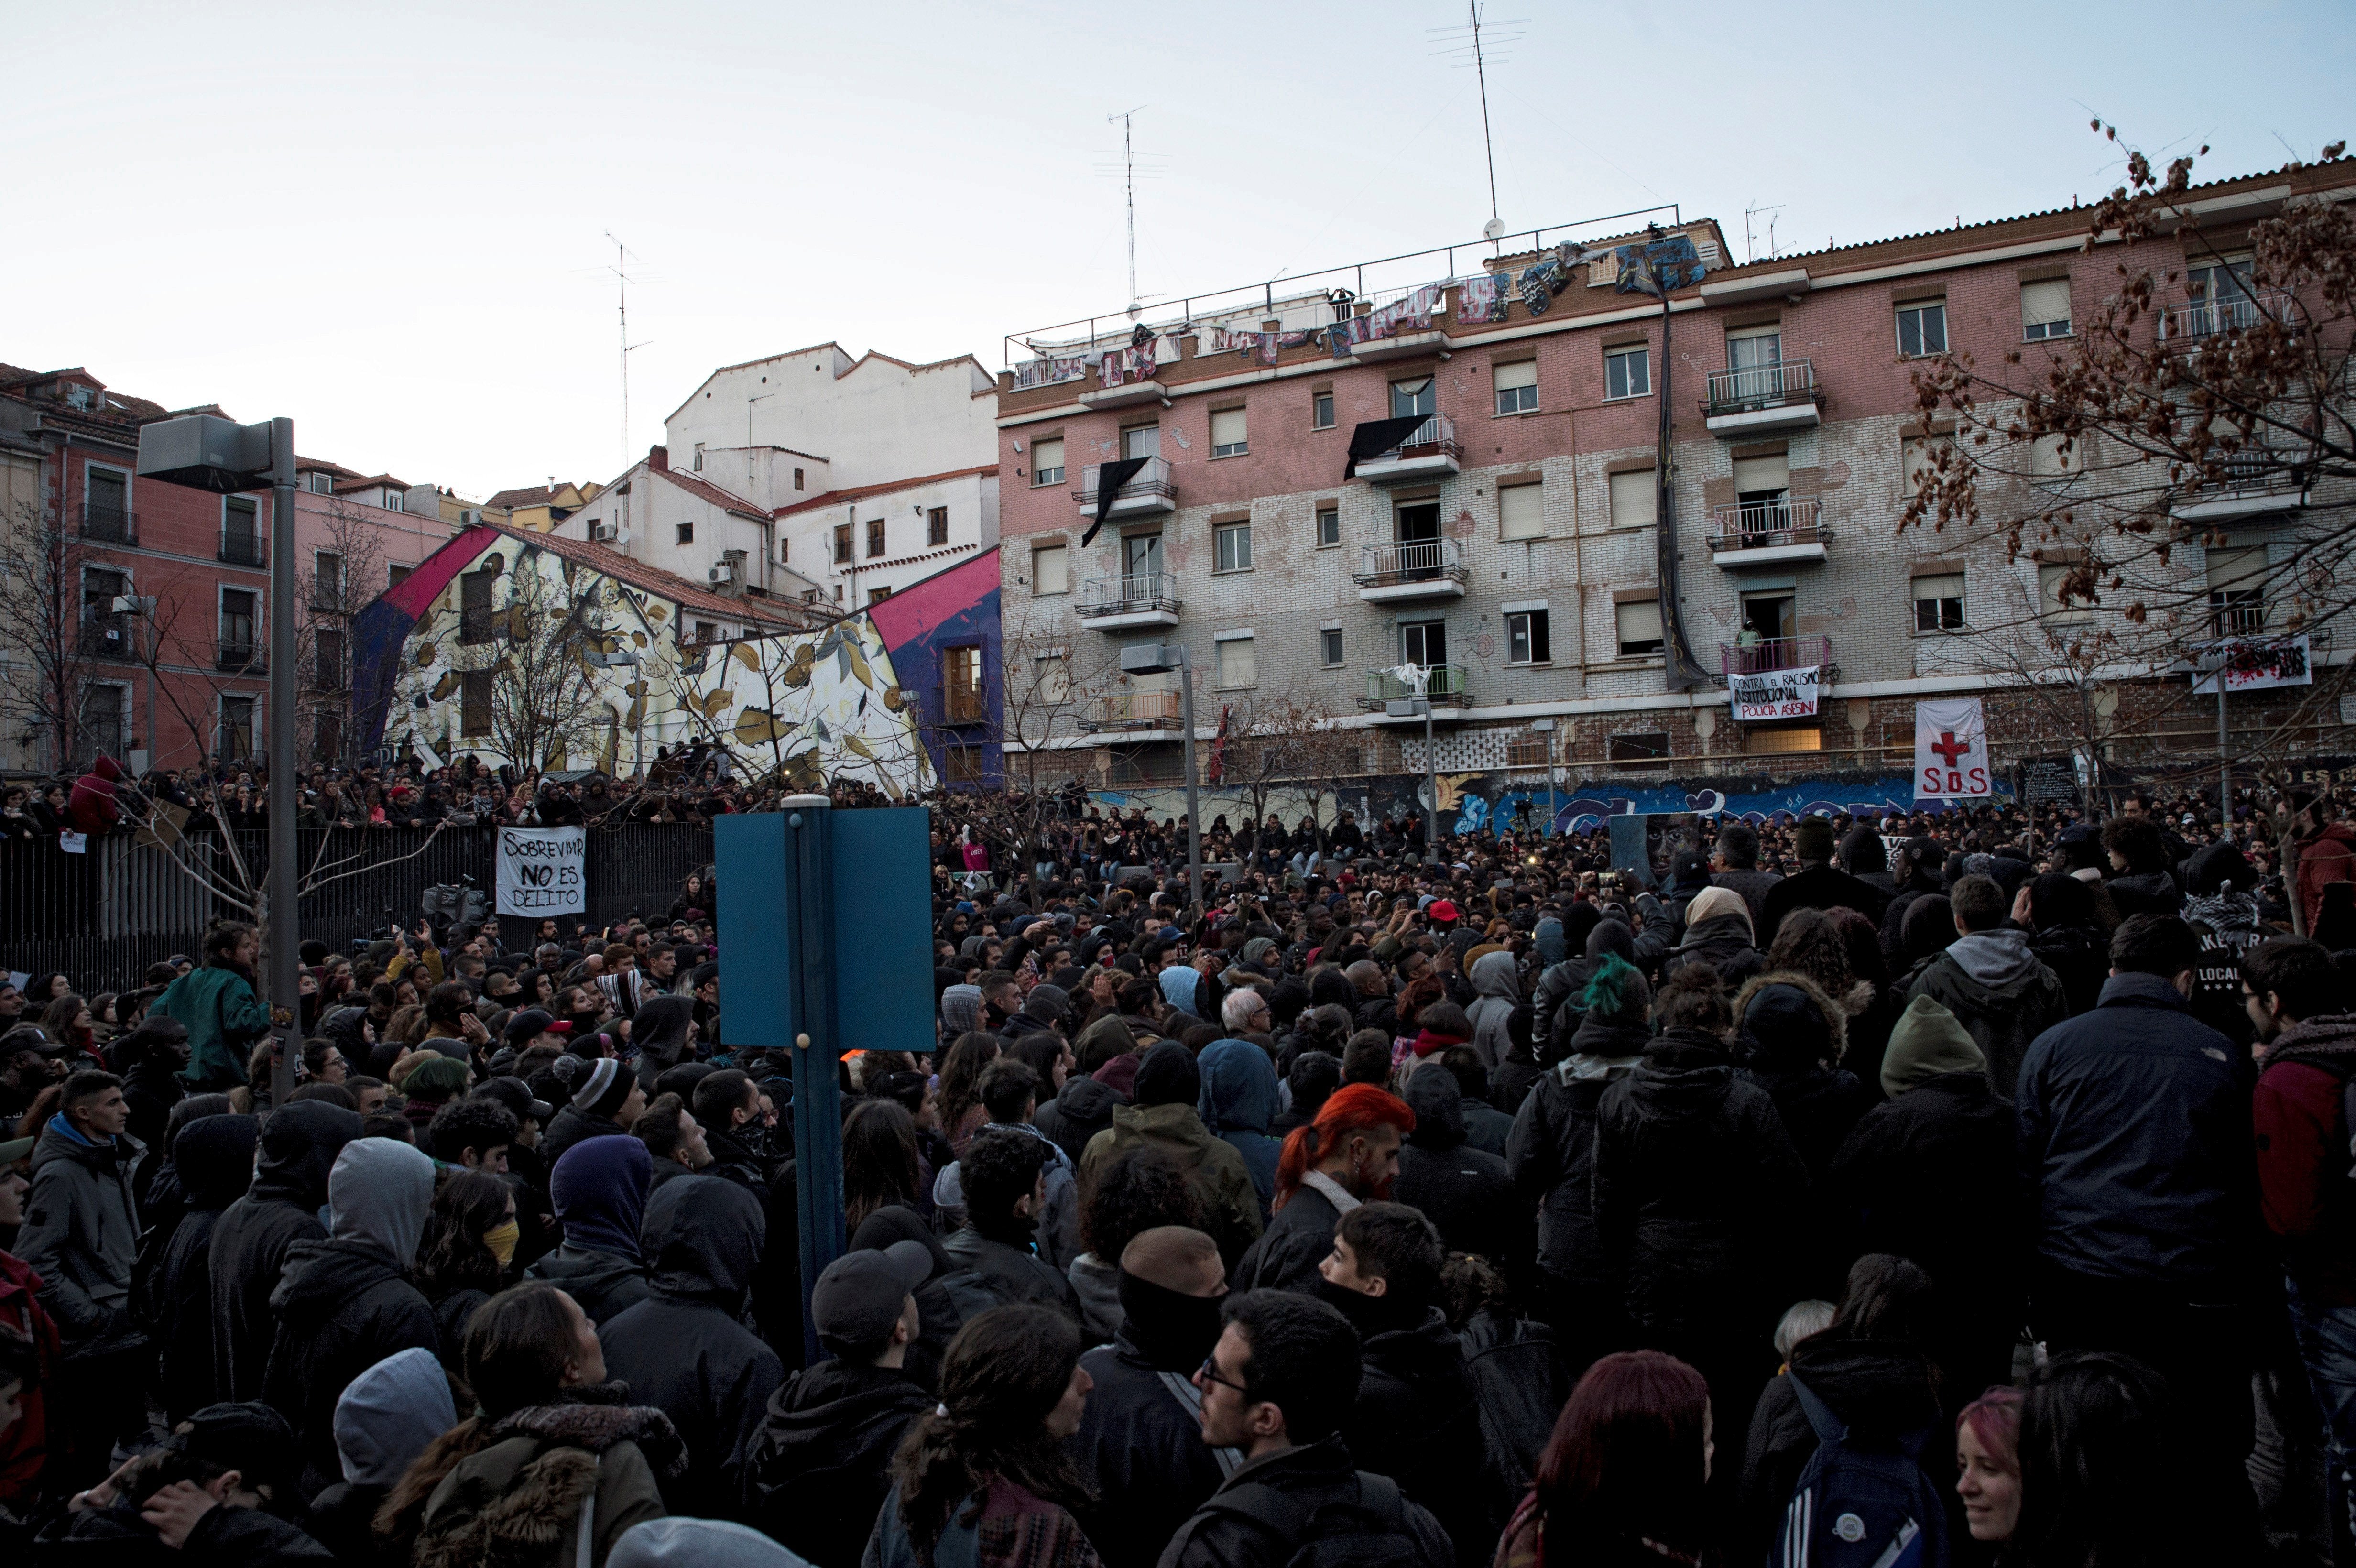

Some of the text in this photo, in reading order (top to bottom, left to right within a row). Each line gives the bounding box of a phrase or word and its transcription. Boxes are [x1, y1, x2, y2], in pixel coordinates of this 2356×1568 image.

[1734, 677, 1765, 690] CONTRA
[1782, 671, 1819, 686] RACISMO
[1734, 687, 1802, 704] INSTITUCIONAL
[2302, 770, 2330, 783] ES
[504, 832, 584, 859] SOBREVIVIR
[521, 865, 578, 887] NO ES
[512, 889, 578, 907] DELITO
[2198, 967, 2241, 981] LOCAL
